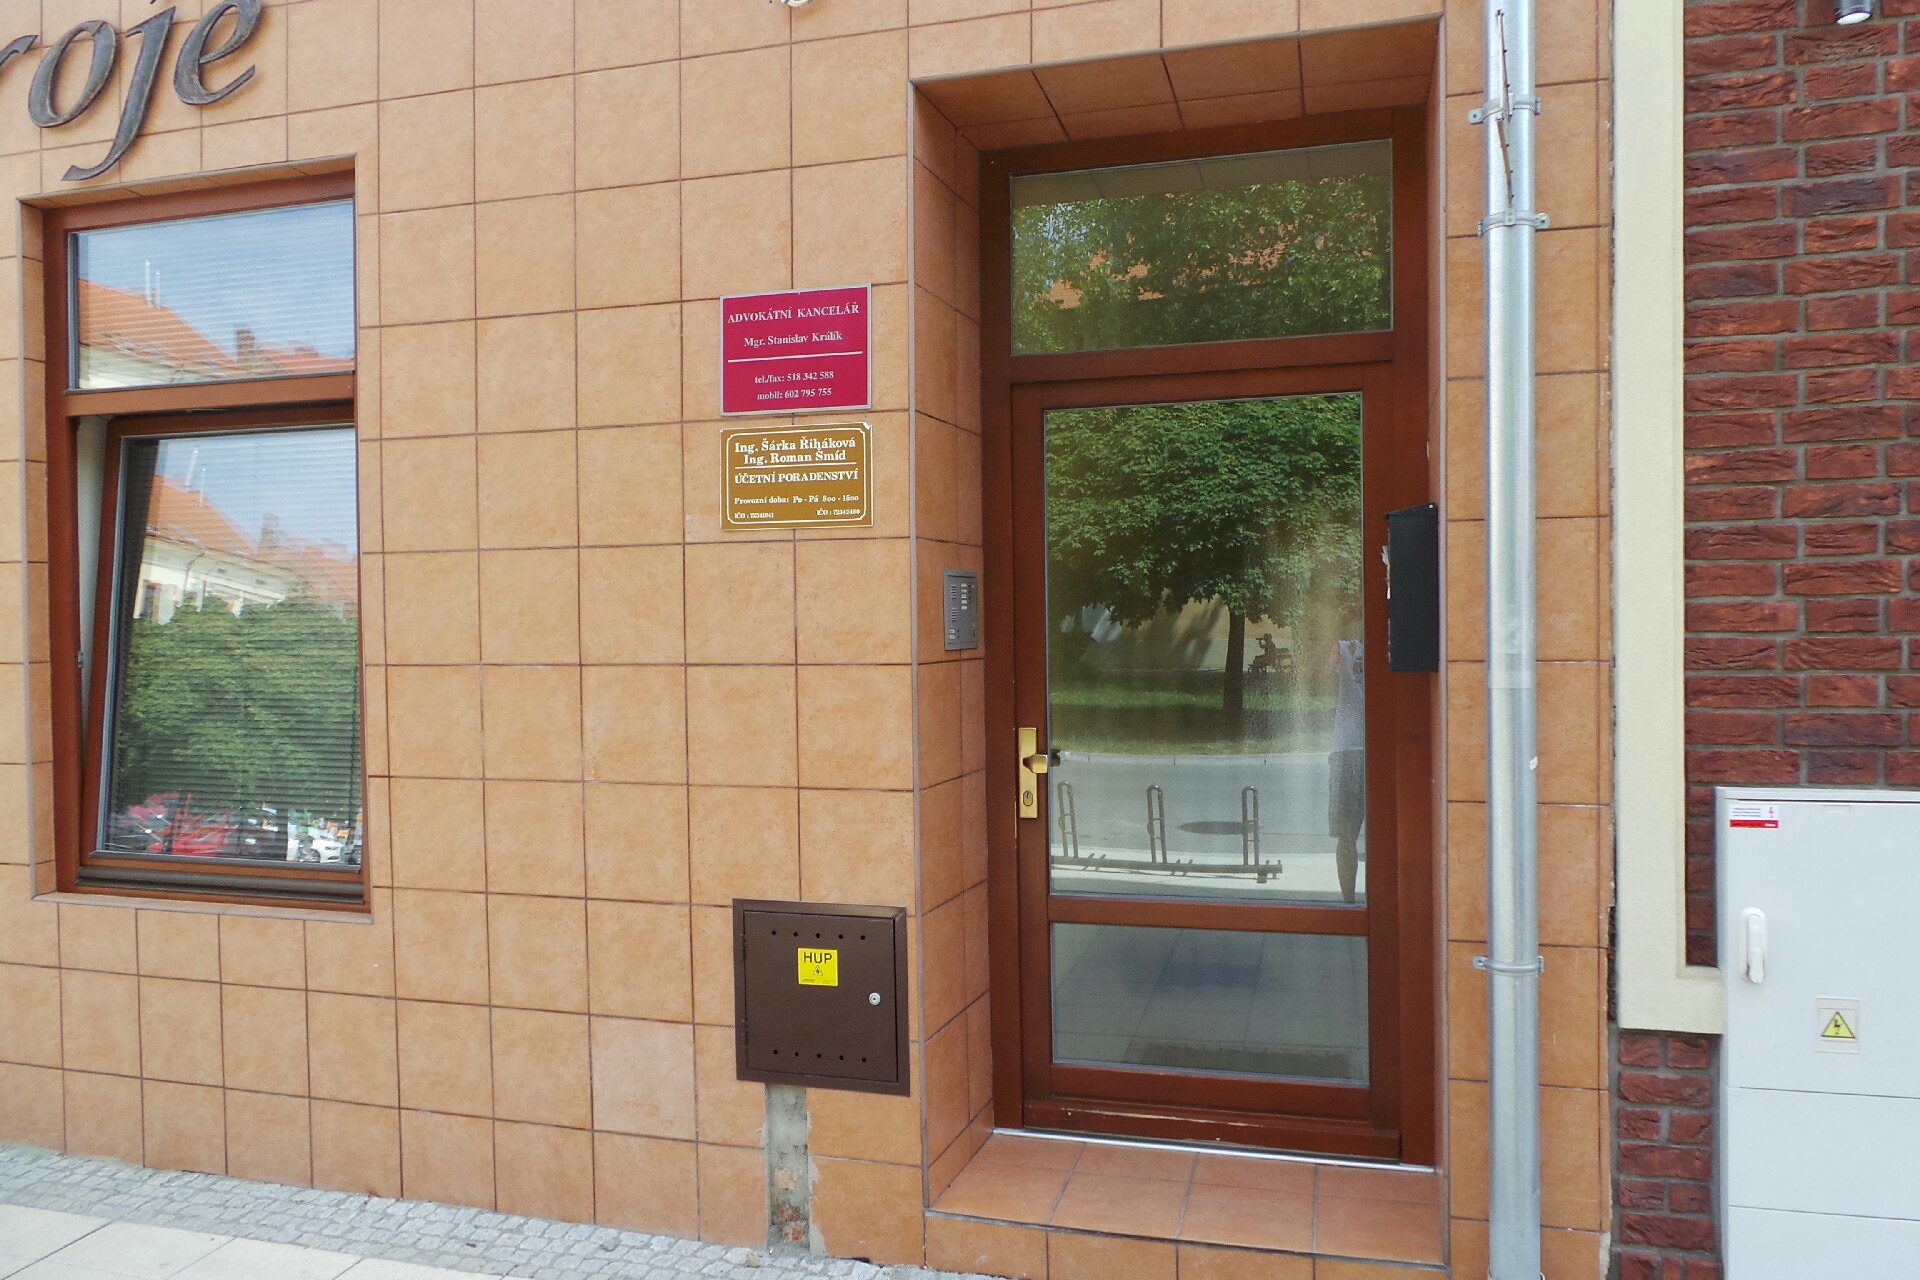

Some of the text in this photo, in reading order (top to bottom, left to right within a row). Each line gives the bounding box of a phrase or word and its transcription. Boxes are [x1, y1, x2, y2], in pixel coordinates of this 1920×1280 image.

[0, 0, 262, 182] oje
[728, 302, 859, 323] ADVOKÁTNÍ KANCELÁŘ
[744, 331, 842, 348] Mgr. Stanislav Králík
[754, 371, 834, 384] tel./fax: 518 342 588
[757, 387, 832, 400] mobil: 602 795 755
[735, 436, 856, 454] Ing. Šárka Řiháková
[744, 448, 846, 466] Ing. Roman Šmíd
[735, 468, 858, 484] ÚČETNÍ PORADENSTVÍ
[734, 496, 767, 504] Provozní
[769, 495, 789, 503] doba:
[793, 495, 803, 503] Po
[808, 495, 819, 503] Pá
[803, 952, 832, 964] HUP
